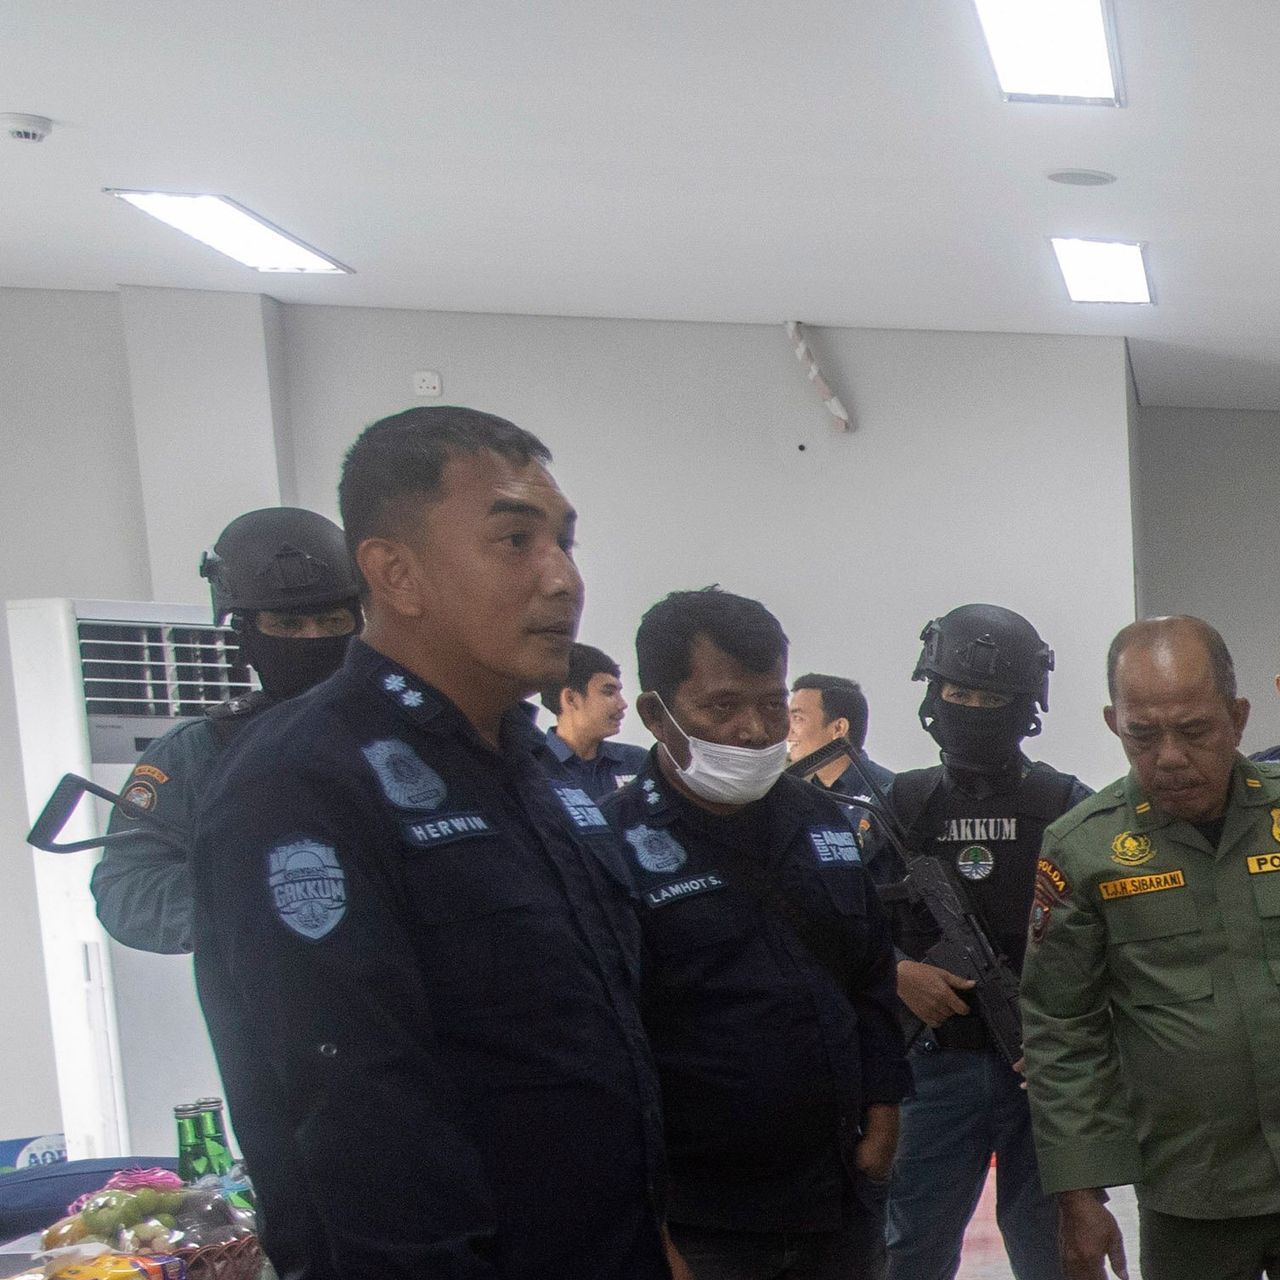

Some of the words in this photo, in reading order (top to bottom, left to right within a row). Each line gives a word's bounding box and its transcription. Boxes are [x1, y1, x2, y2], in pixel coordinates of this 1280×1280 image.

[411, 816, 489, 842] HERWIN
[273, 879, 345, 908] GAKKUM
[648, 877, 708, 904] LAMHOT
[708, 875, 722, 887] S.
